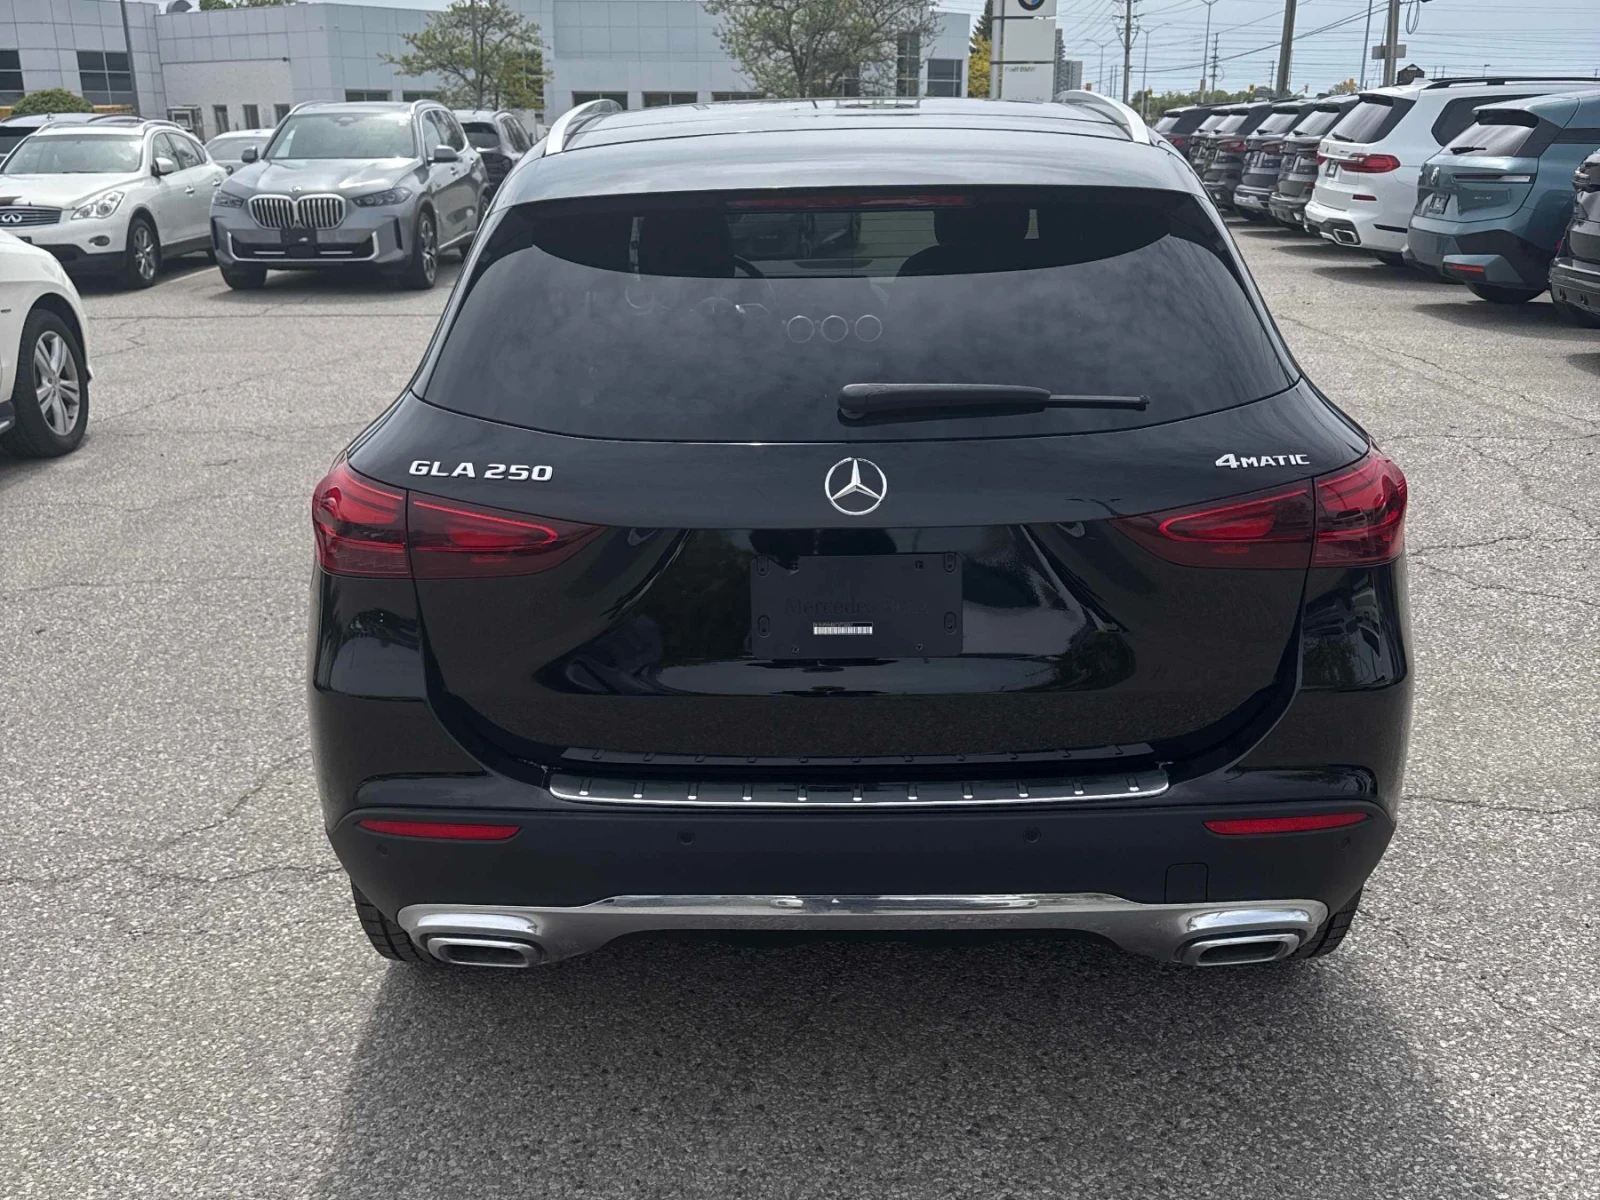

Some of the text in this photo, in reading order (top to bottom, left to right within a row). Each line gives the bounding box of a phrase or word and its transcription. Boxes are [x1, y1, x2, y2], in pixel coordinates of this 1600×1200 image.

[1215, 453, 1311, 469] 4MATIC
[408, 460, 554, 482] GLA 250
